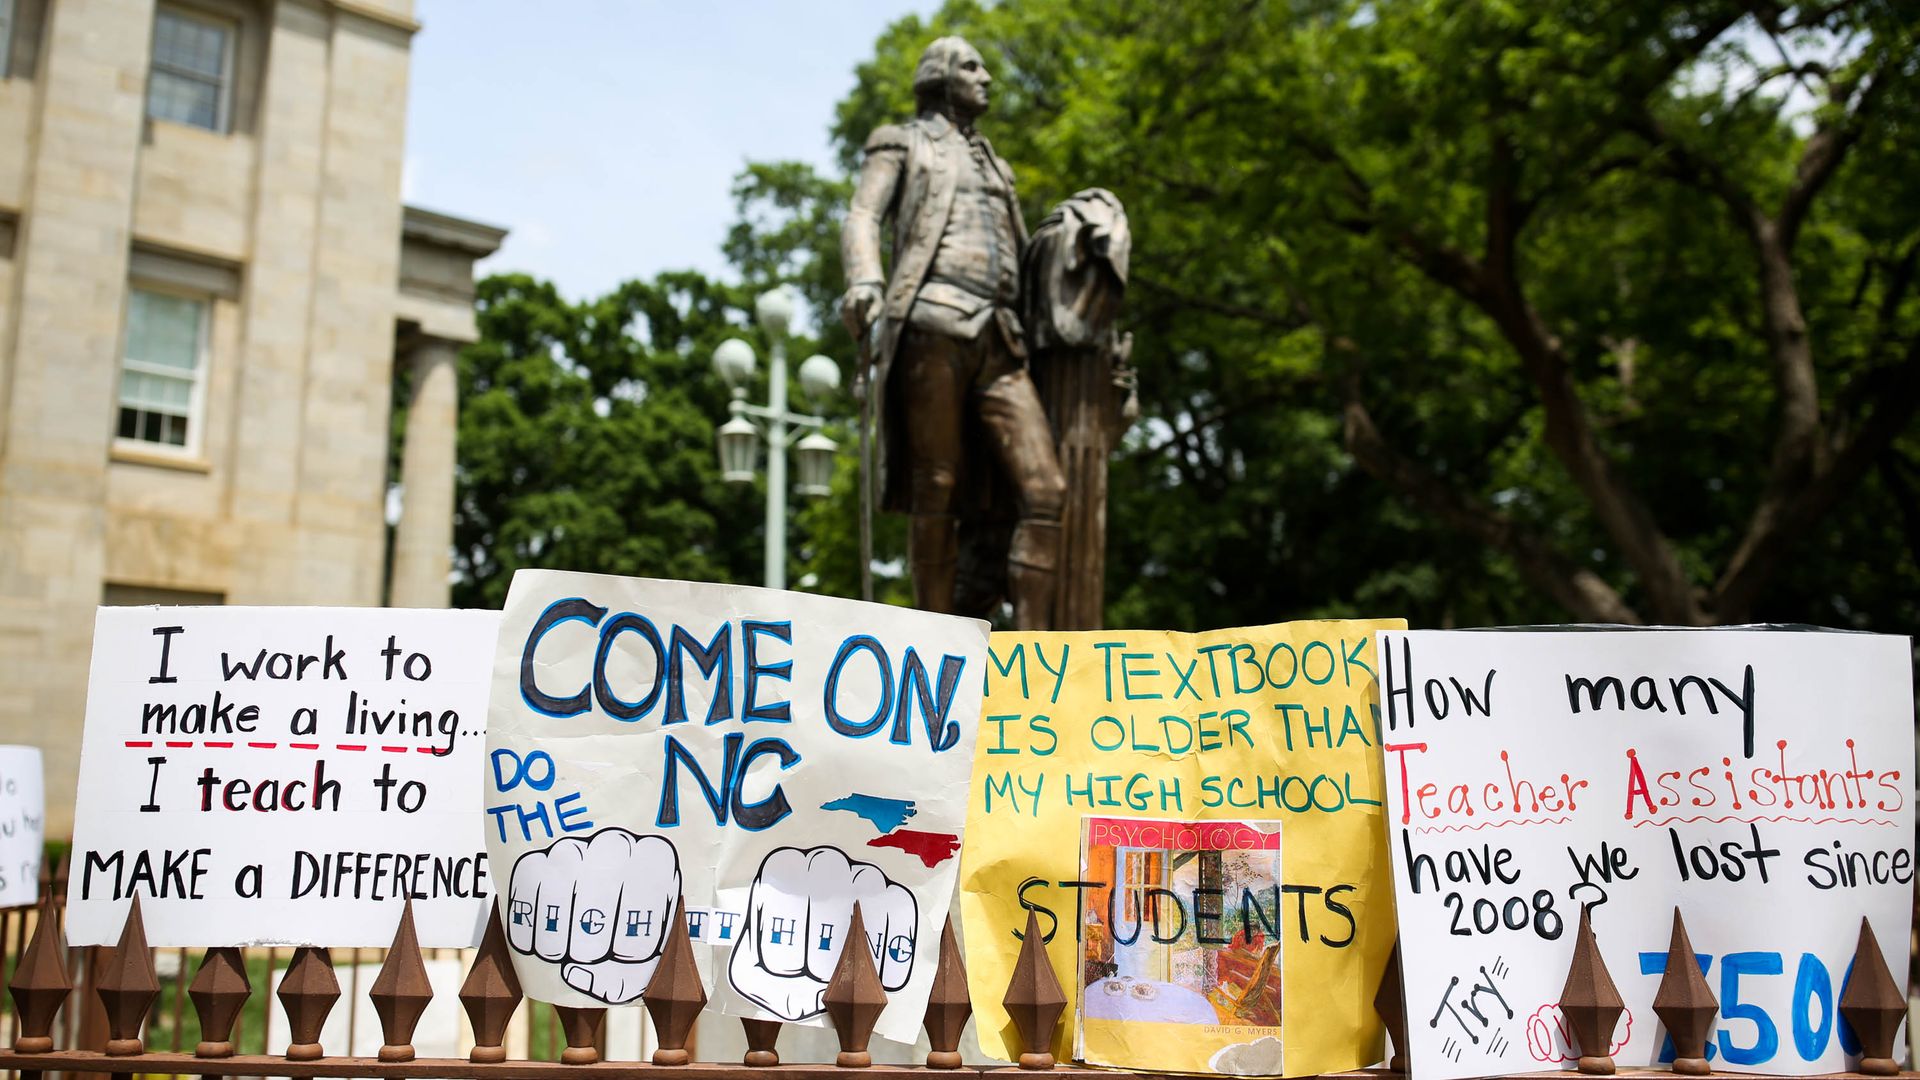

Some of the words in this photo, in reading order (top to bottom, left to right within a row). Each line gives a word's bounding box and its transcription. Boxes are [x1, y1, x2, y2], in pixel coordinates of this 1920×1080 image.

[149, 626, 185, 684] I
[221, 635, 348, 681] work
[381, 635, 432, 681] to
[520, 597, 793, 726] COME
[824, 634, 966, 753] ON,
[984, 641, 1069, 703] MY
[1094, 637, 1379, 702] TEXTBOOK
[141, 691, 260, 735] make
[290, 707, 317, 735] a
[1384, 635, 1497, 731] How
[1565, 664, 1756, 758] many
[986, 715, 1058, 756] IS
[1091, 708, 1254, 755] OLDER
[140, 757, 167, 812] I
[197, 760, 341, 812] teach
[373, 763, 427, 813] to
[490, 749, 556, 792] DO
[655, 733, 801, 831] NC
[985, 771, 1044, 817] MY
[1066, 772, 1183, 812] HIGH
[1201, 772, 1382, 813] SCHOOL
[1384, 742, 1589, 825] Teacher
[1624, 739, 1904, 819] Assistants
[487, 792, 594, 844] THE
[1094, 824, 1271, 851] PSYCHOLOGY
[82, 848, 211, 901] MAKE
[235, 864, 262, 898] a
[290, 850, 488, 900] DIFFERENCE
[1403, 828, 1521, 894] have
[1669, 823, 1780, 883] lost
[1803, 840, 1914, 889] since
[1011, 876, 1356, 948] STUDENTS
[1204, 1026, 1231, 1035] DAVID
[1248, 1027, 1278, 1037] MYERS
[1430, 966, 1514, 1045] Try
